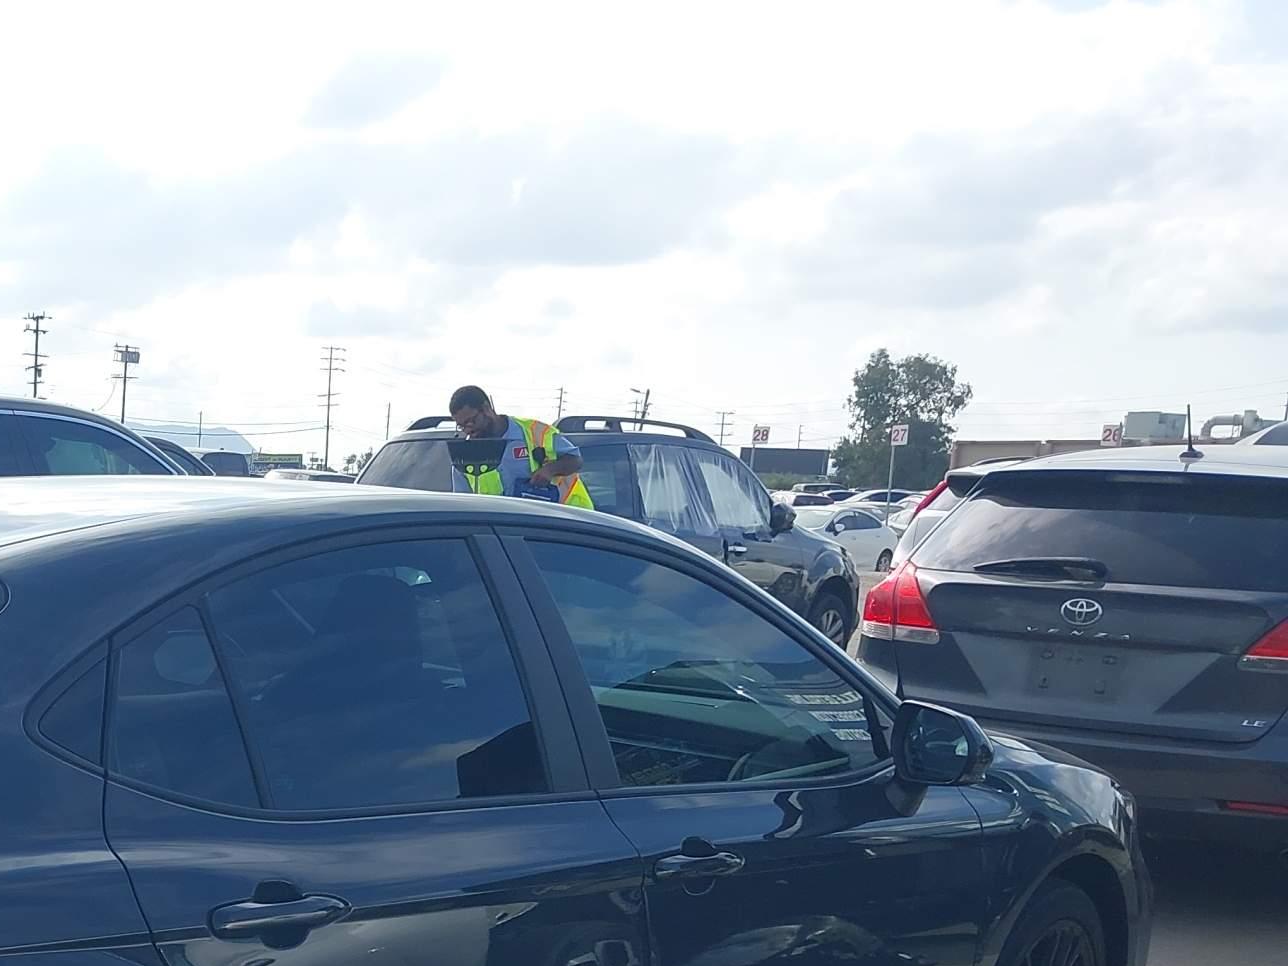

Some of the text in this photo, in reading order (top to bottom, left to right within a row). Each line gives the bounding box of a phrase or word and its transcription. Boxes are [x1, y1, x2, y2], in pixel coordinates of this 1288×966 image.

[753, 429, 769, 441] 28
[892, 429, 907, 442] 27
[1241, 719, 1267, 728] LE
